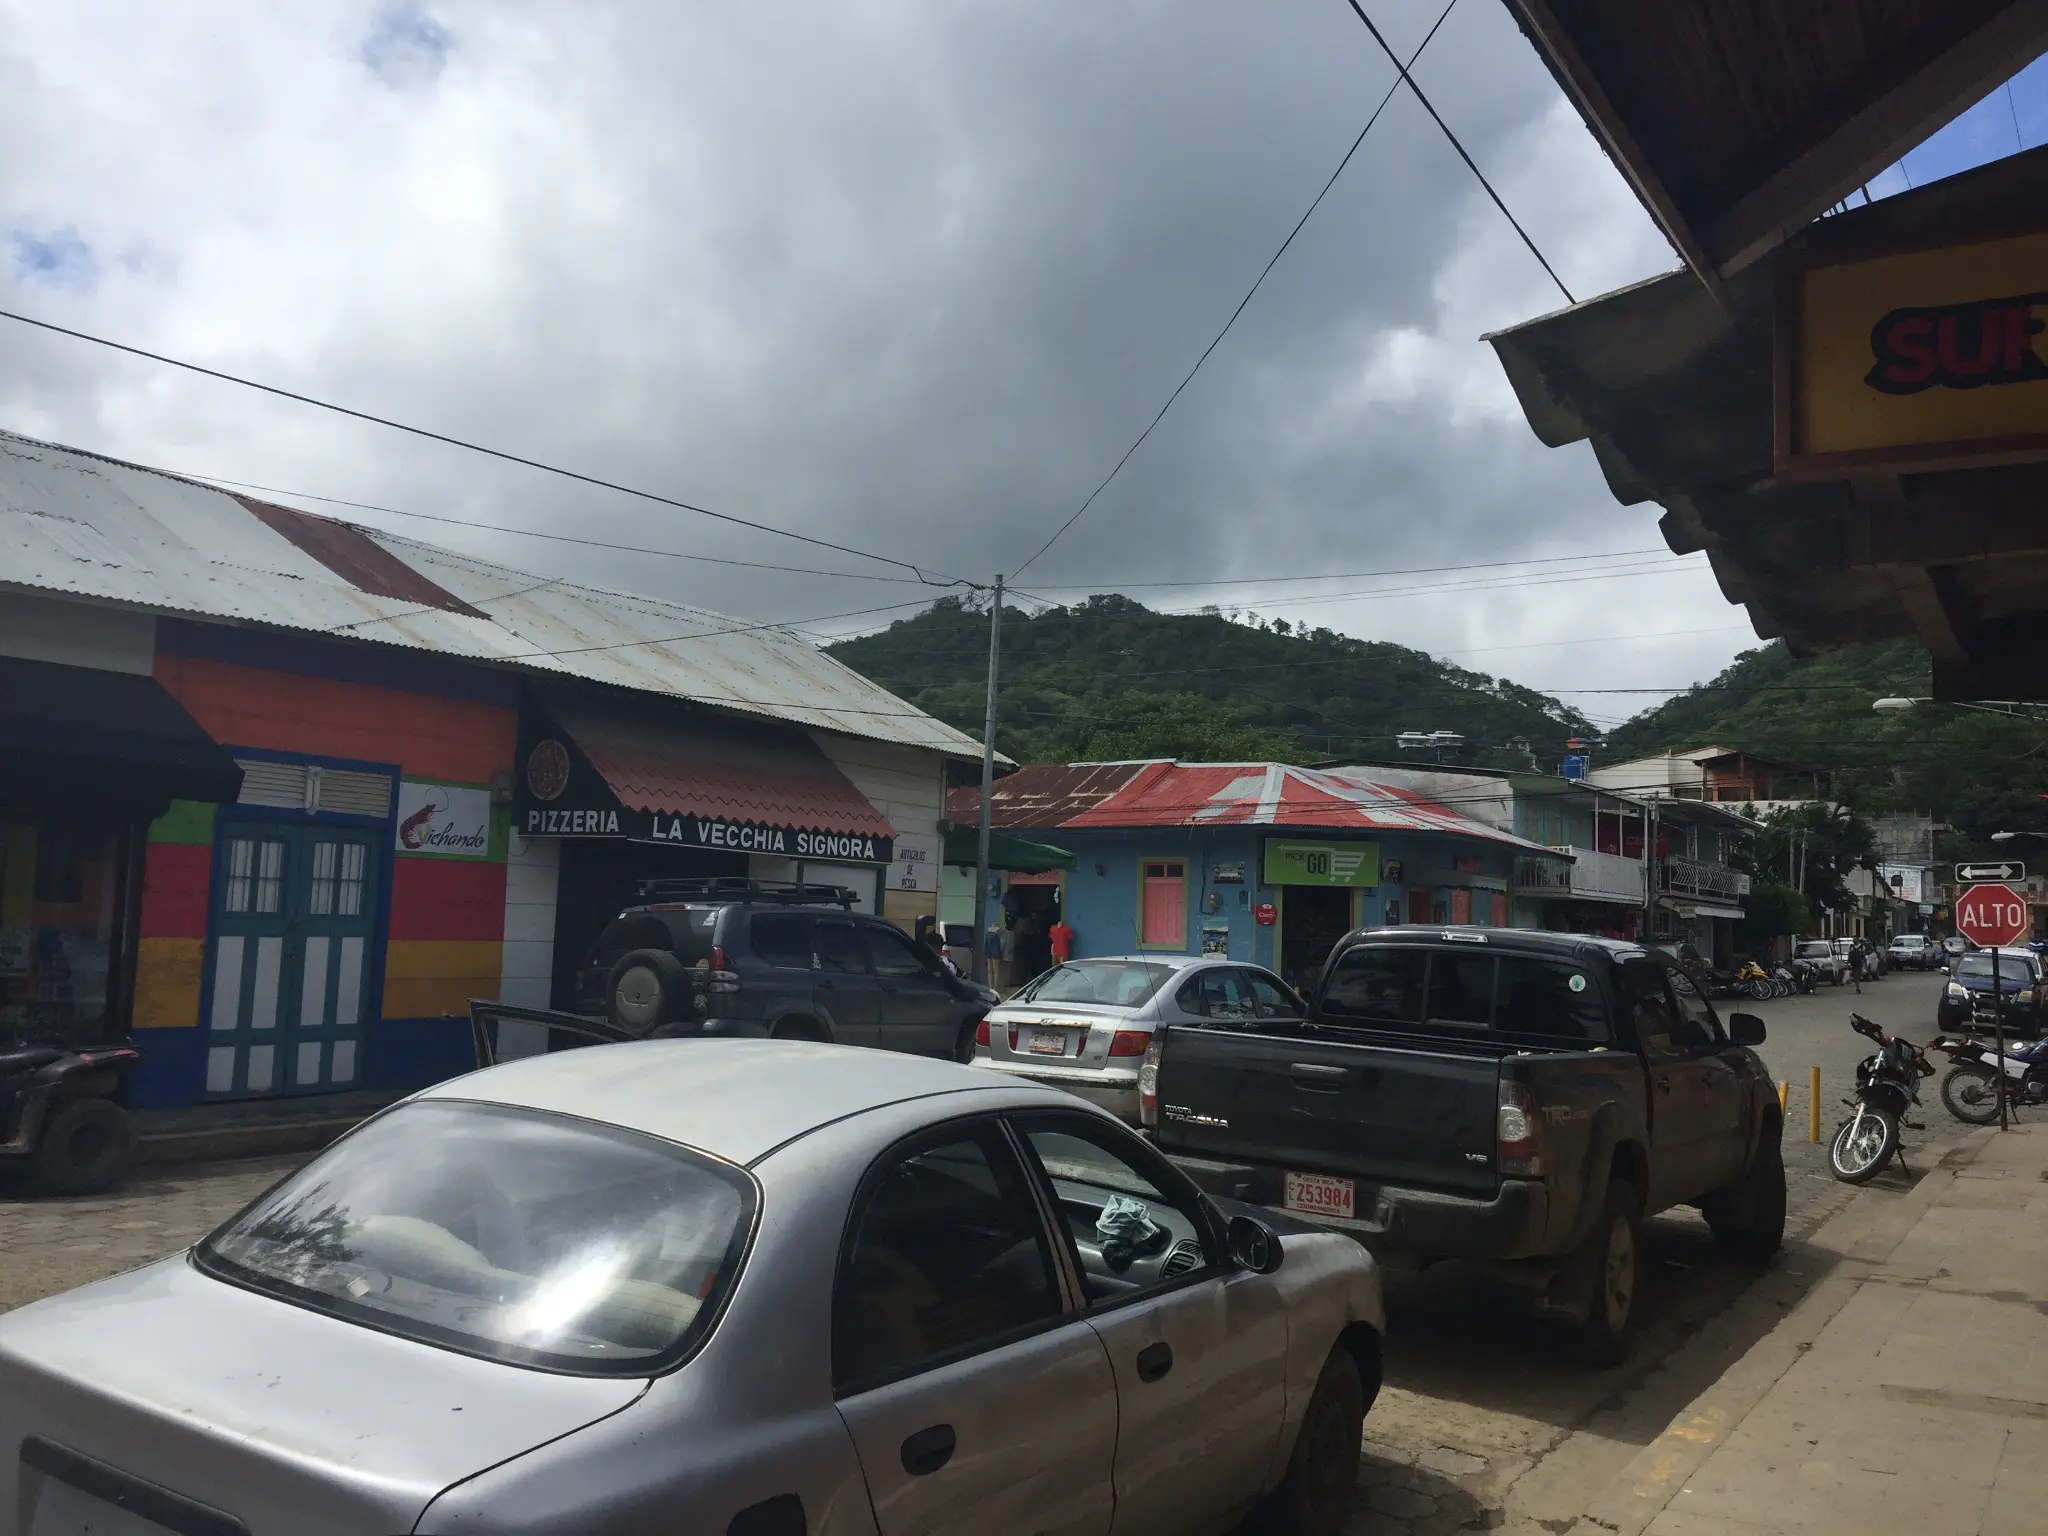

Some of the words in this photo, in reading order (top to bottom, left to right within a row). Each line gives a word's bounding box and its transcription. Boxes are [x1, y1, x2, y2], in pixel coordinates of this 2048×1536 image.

[527, 810, 619, 832] PIZZERIA
[652, 816, 683, 840] LA
[698, 821, 785, 851] VECCHIA
[797, 832, 875, 859] SIGNORA
[1962, 903, 2021, 928] ALTO
[1164, 1104, 1192, 1114] TOYOTA
[1165, 1111, 1229, 1128] TACOMA
[1540, 1104, 1571, 1127] TRD
[1465, 1153, 1488, 1163] V6
[1296, 1182, 1352, 1209] 253984
